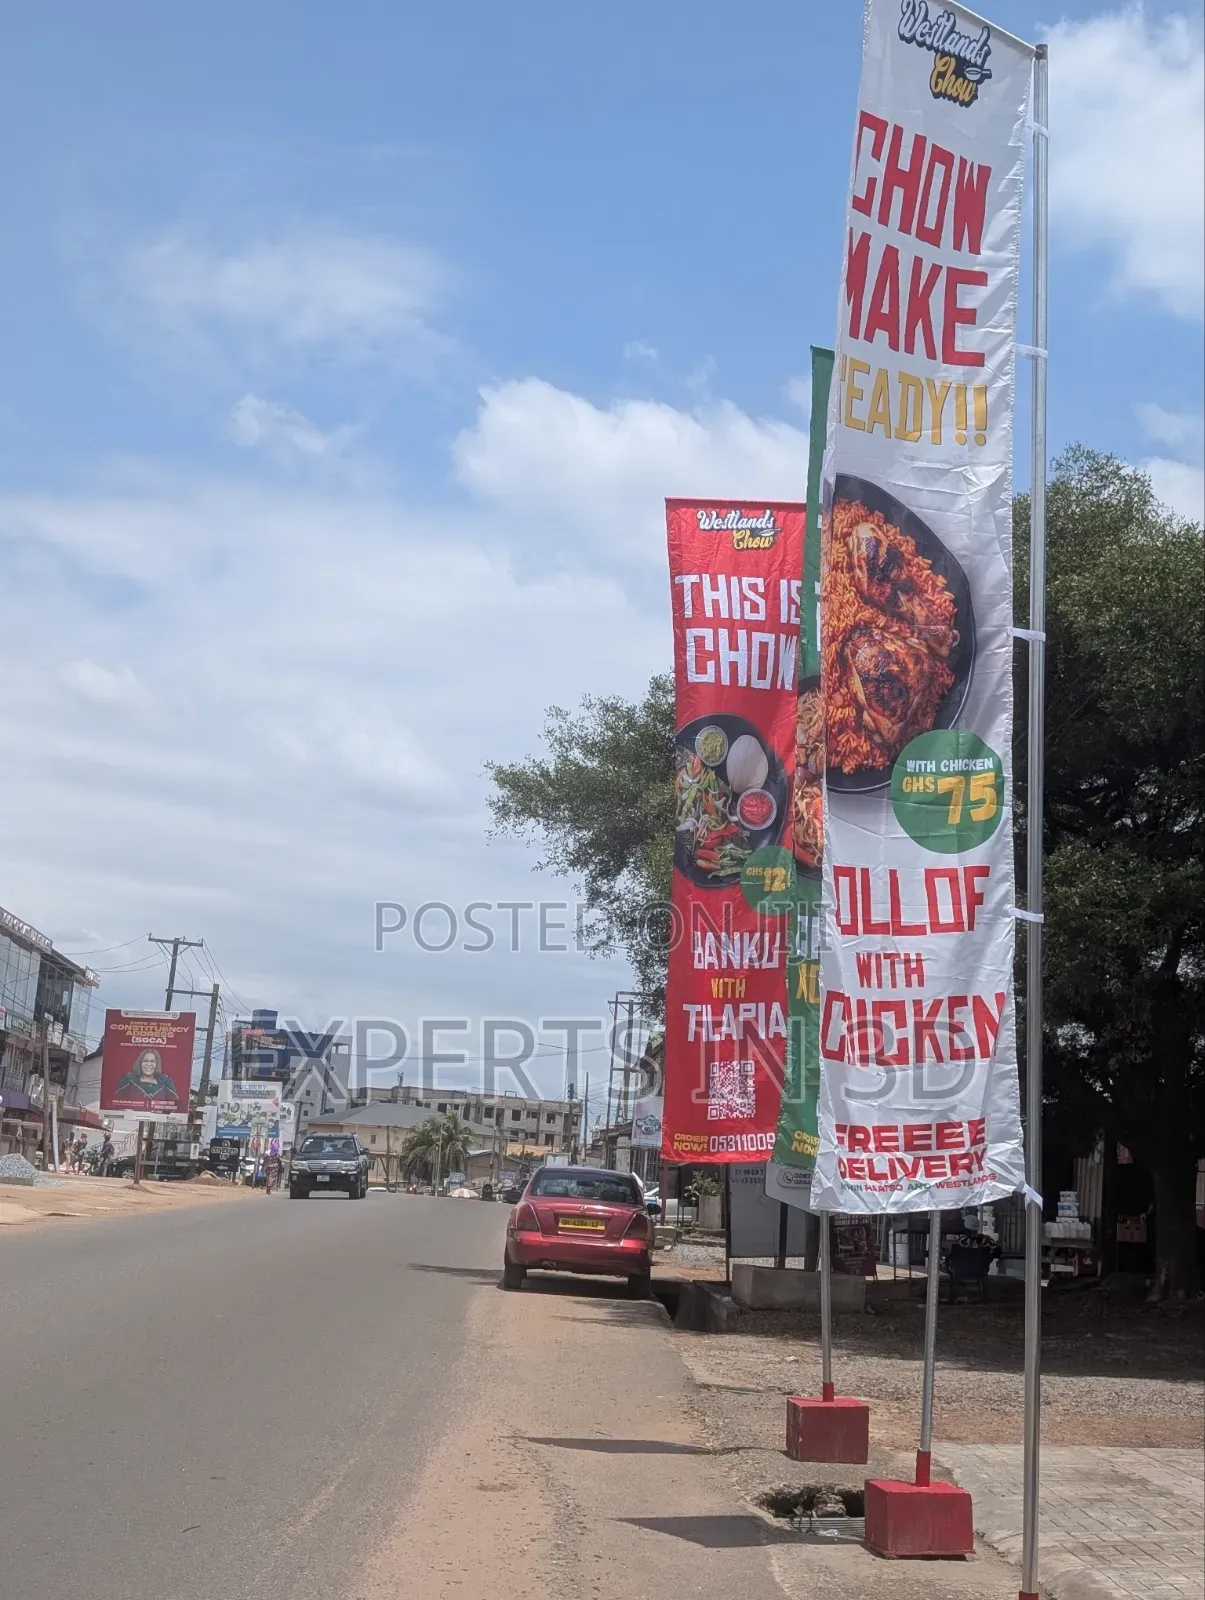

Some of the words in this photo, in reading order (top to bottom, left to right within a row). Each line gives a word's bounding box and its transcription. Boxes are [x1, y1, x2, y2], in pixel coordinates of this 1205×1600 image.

[900, 0, 991, 67] Westlands
[930, 52, 978, 104] Chow
[851, 109, 992, 256] CHOW
[846, 226, 988, 368] MAKE
[839, 354, 988, 447] EADY!!
[697, 509, 776, 532] Westlands
[732, 528, 775, 550] Chow
[675, 574, 766, 621] THIS
[686, 628, 798, 691] CHOW
[907, 759, 936, 773] WITH
[940, 758, 994, 772] CHICKEN
[902, 776, 936, 793] GHS
[937, 772, 998, 825] 75
[746, 866, 764, 876] GHS
[763, 866, 792, 892] 12
[711, 977, 746, 999] WITH
[856, 952, 925, 989] WITH
[110, 1024, 190, 1033] CONSTITUENCY
[682, 1001, 787, 1042] TILAPIA
[673, 1141, 708, 1152] NOW!
[674, 1132, 709, 1143] ORDER
[837, 1147, 988, 1181] DELIVERY
[907, 1182, 932, 1191] AND
[935, 1172, 998, 1189] WESTLANDS
